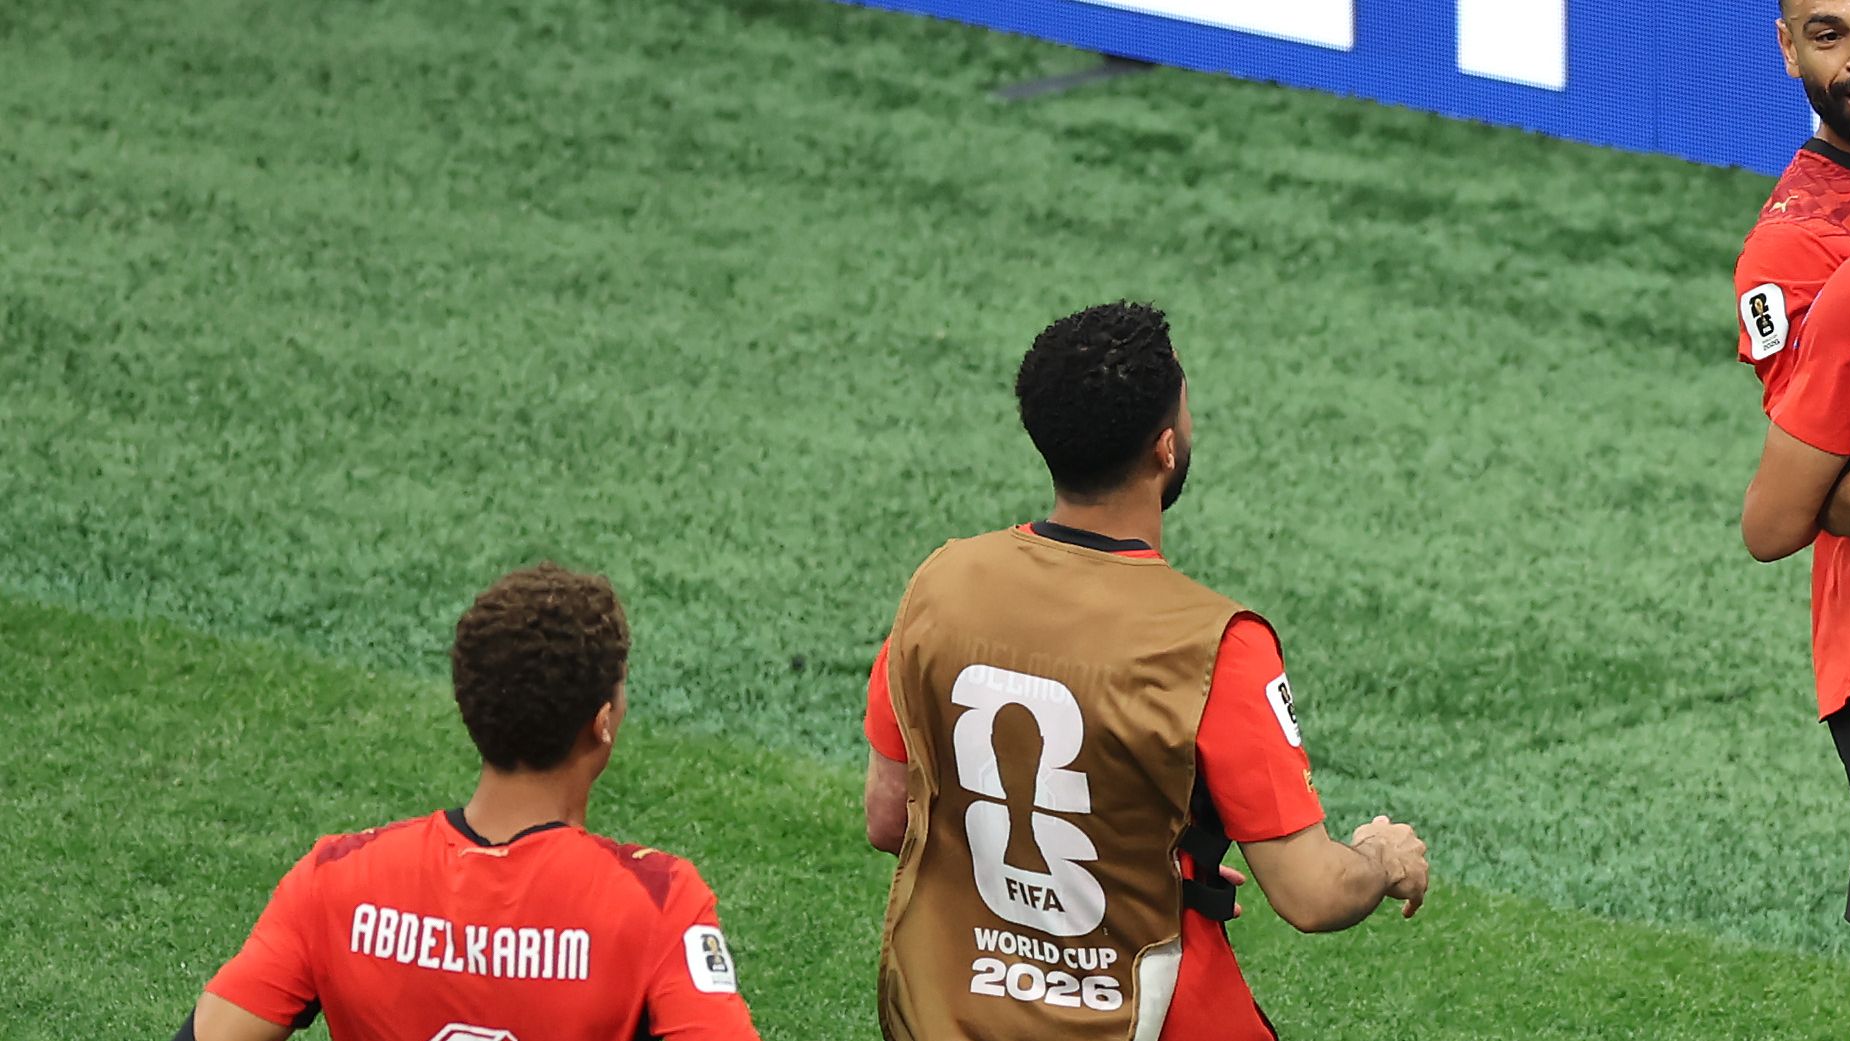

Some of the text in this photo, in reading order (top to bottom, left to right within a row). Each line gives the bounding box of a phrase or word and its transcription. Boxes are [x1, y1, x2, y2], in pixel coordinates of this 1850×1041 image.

[1005, 877, 1066, 913] FIFA
[351, 903, 590, 980] ABDELKARIM
[973, 927, 1118, 971] WORLD CUP
[970, 957, 1123, 1011] 2026
